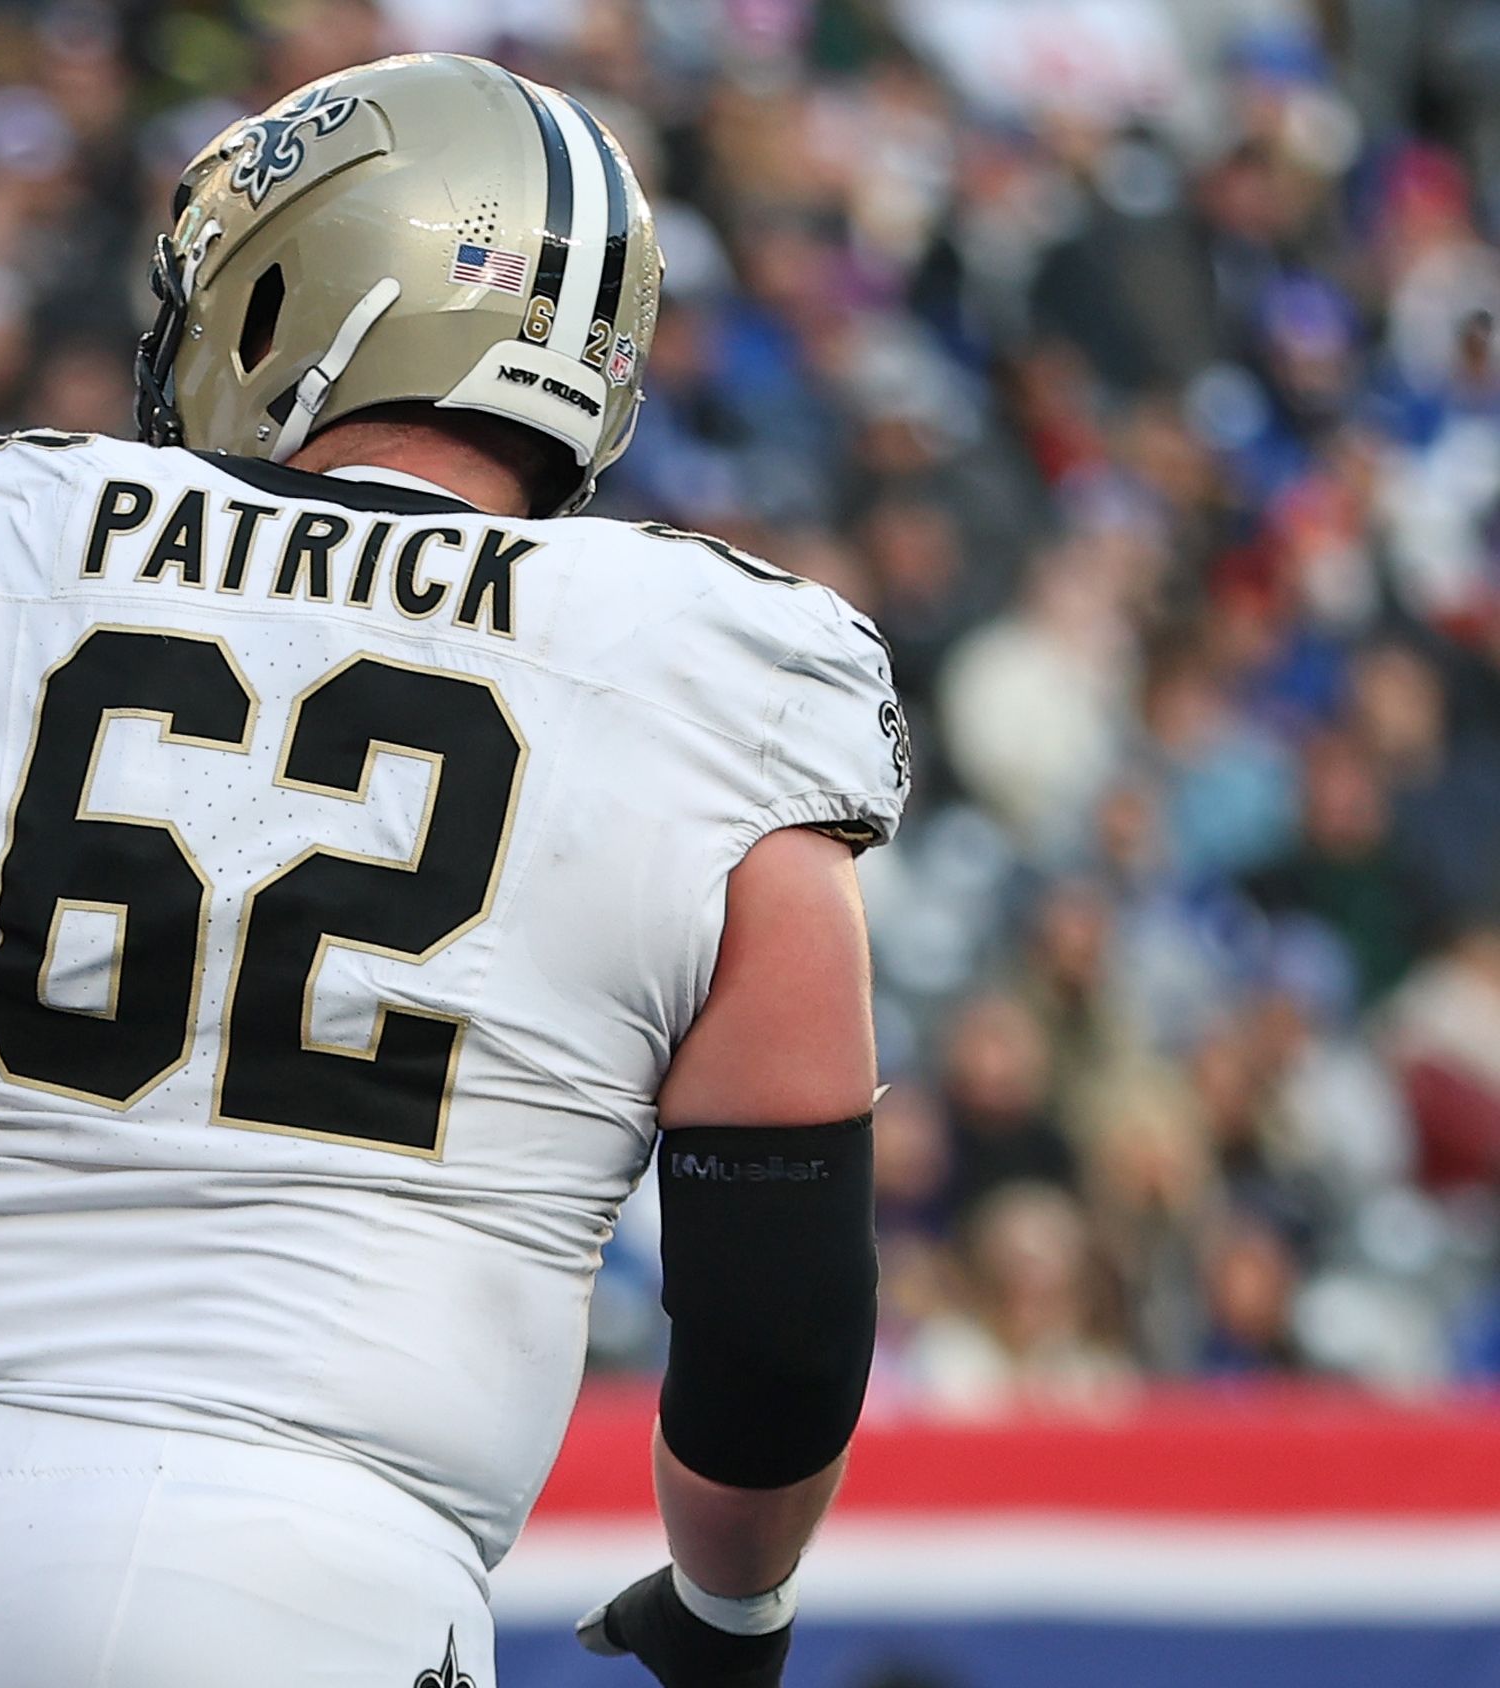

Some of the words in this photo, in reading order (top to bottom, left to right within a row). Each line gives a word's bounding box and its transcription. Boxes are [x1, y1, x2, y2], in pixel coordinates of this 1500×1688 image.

[523, 294, 555, 343] 6
[581, 318, 612, 368] 2
[497, 365, 540, 386] NEW
[542, 378, 601, 417] ORLEANS
[79, 479, 546, 640] PATRICK
